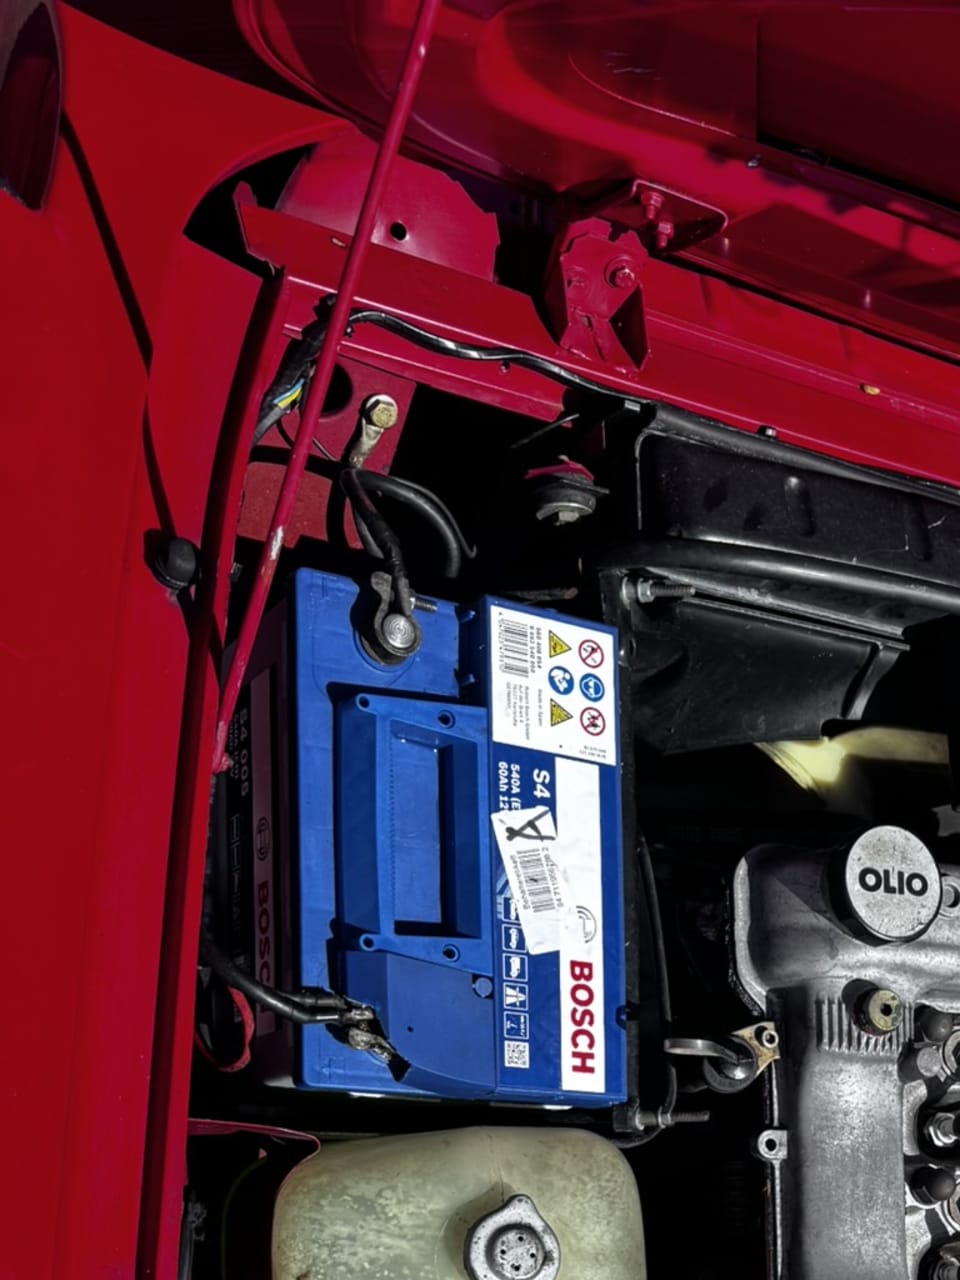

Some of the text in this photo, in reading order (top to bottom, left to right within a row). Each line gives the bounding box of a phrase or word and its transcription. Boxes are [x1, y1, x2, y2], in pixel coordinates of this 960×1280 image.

[498, 761, 508, 791] 60Ah
[511, 763, 520, 793] 540A
[533, 768, 551, 798] S4
[858, 868, 929, 897] OLIO
[570, 960, 595, 1074] BOSCH
